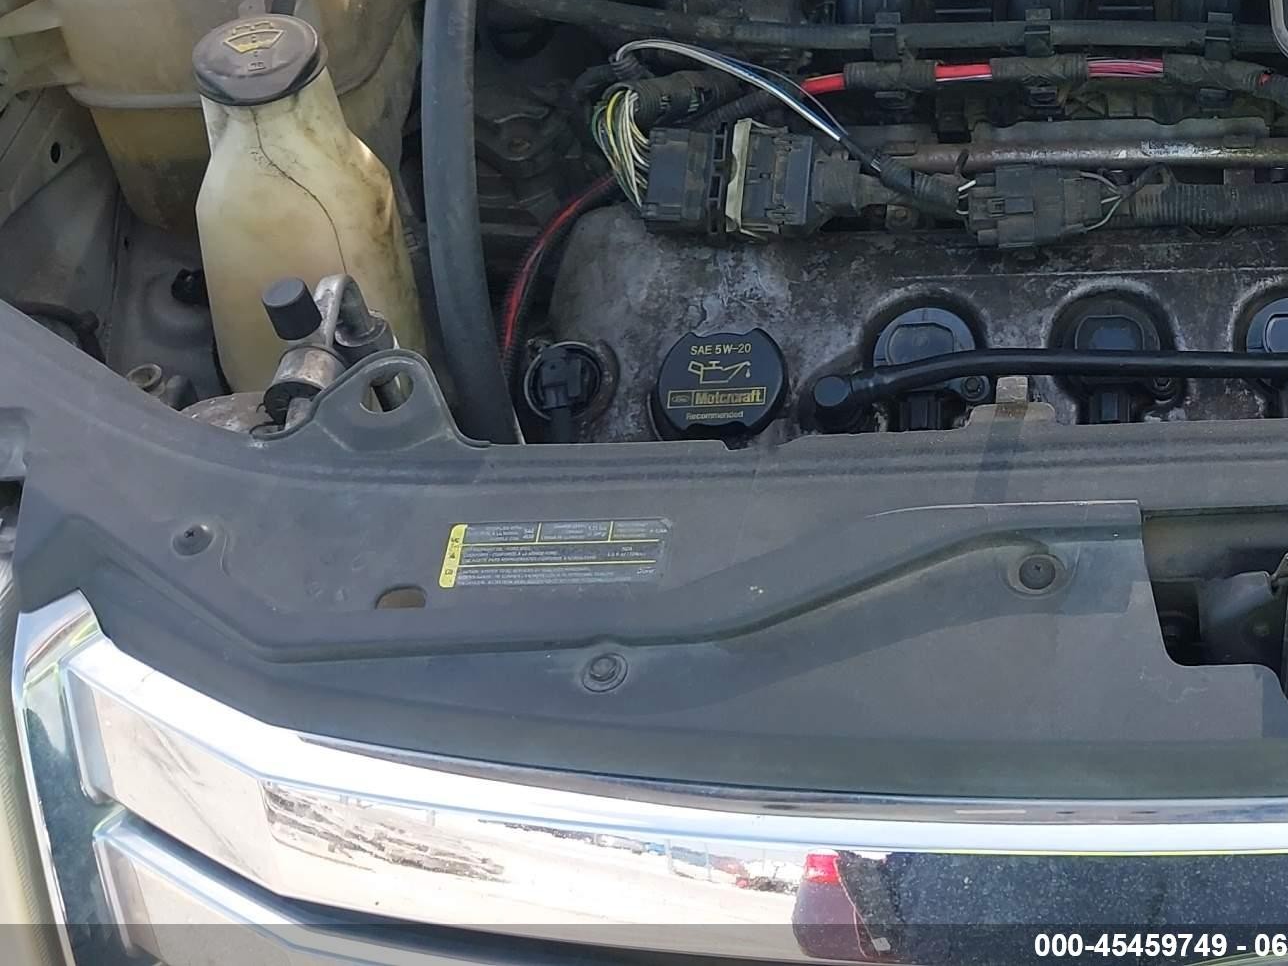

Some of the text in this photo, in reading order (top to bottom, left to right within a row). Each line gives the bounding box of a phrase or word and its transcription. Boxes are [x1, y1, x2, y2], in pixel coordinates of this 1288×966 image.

[690, 342, 752, 356] SAE 5W-20
[695, 389, 763, 405] Motorcraft
[686, 410, 744, 421] Recommended
